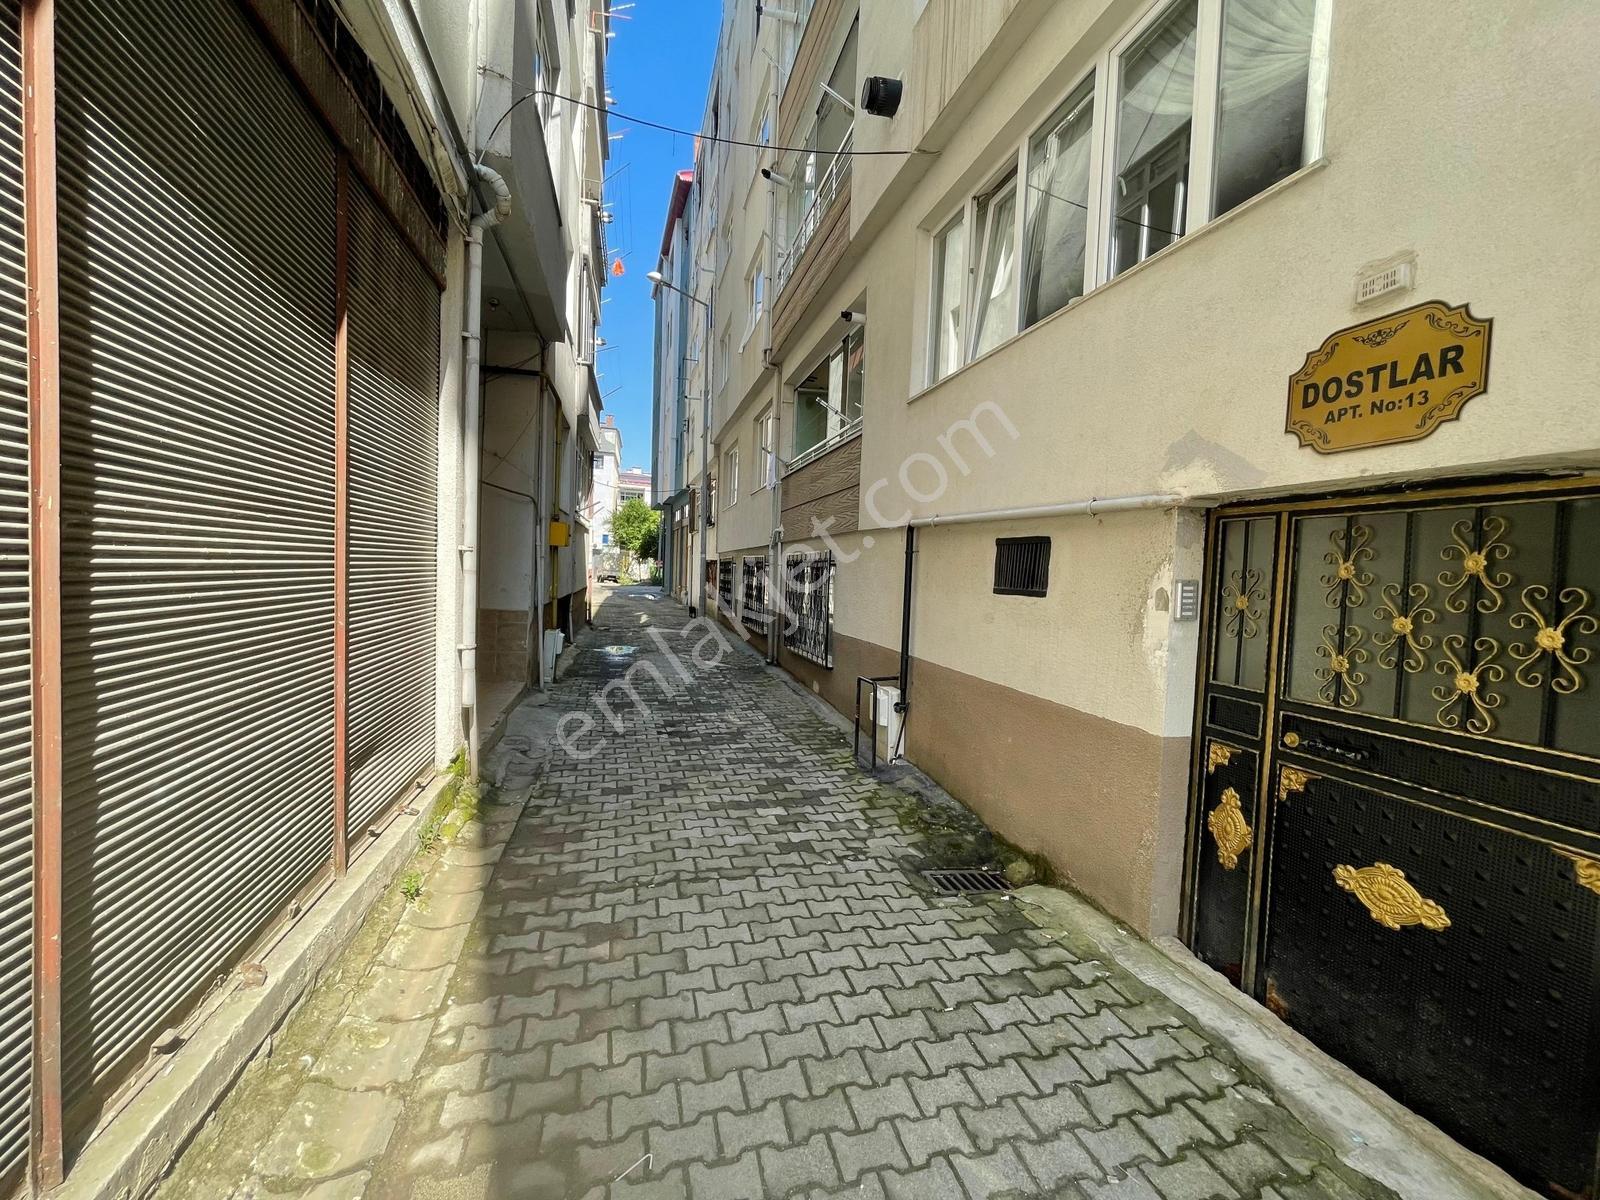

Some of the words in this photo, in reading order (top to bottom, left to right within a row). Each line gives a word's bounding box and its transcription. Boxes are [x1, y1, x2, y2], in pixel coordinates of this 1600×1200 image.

[1302, 344, 1464, 409] DOSTLAR
[1324, 404, 1363, 424] APT.
[1370, 390, 1429, 416] No:13
